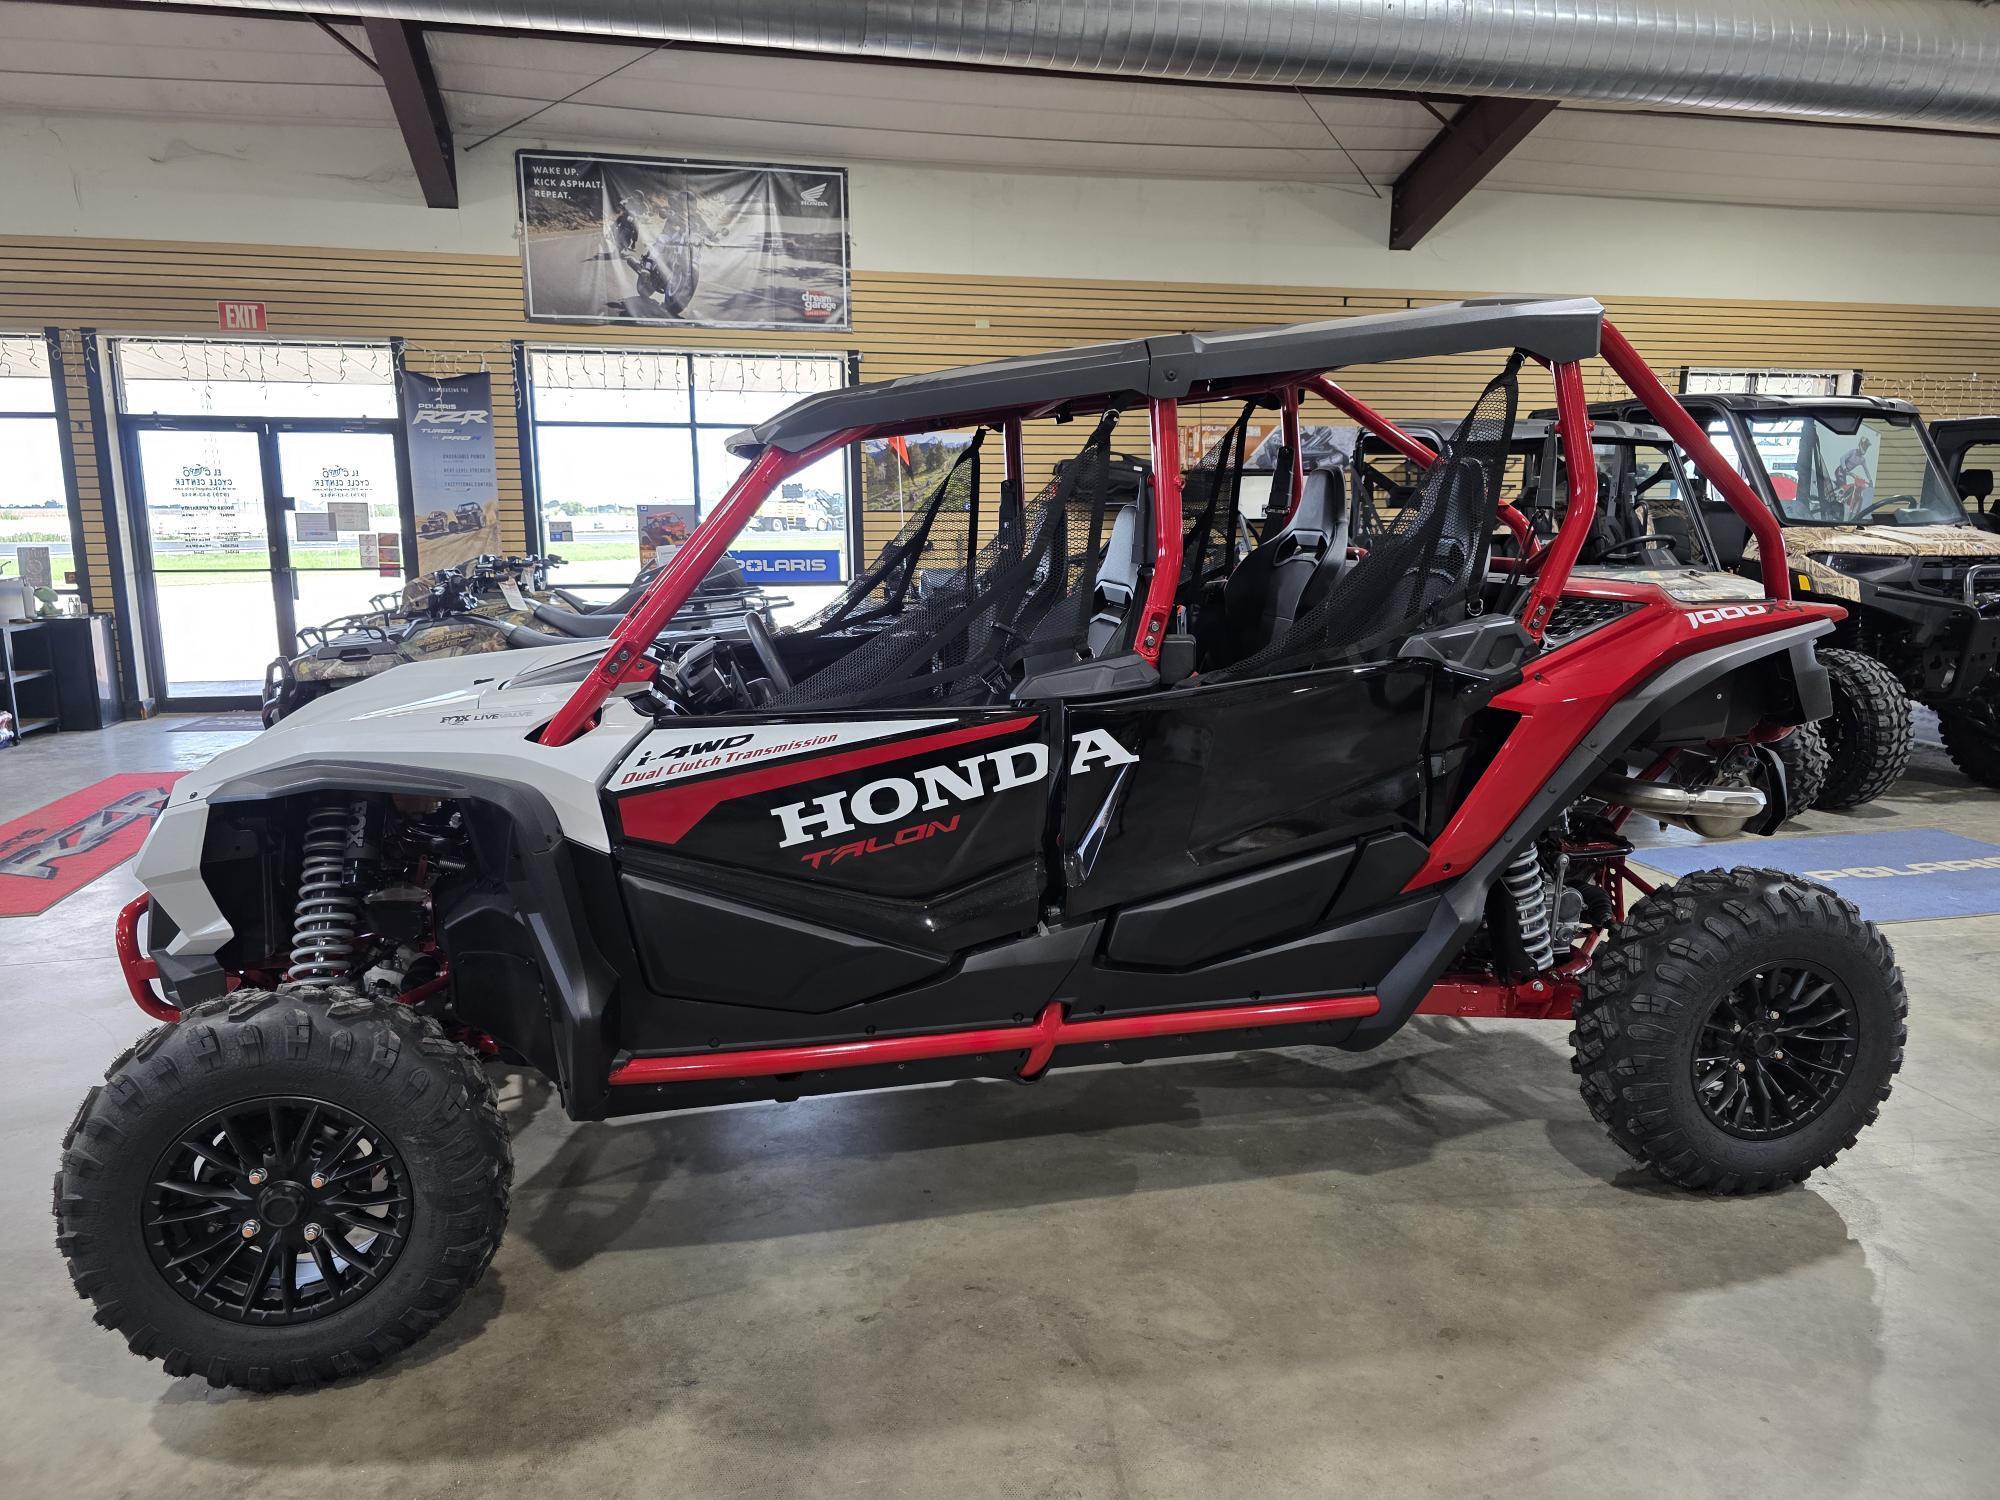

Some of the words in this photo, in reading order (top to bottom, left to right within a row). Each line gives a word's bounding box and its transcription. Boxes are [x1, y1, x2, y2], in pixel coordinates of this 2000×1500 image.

[533, 166, 560, 174] WAKE
[564, 168, 579, 176] UP.
[560, 181, 604, 189] ASPHALT.
[535, 190, 571, 200] REPEAT.
[802, 291, 832, 304] dream
[804, 301, 836, 313] garage
[225, 304, 258, 329] EXIT
[412, 410, 489, 425] RZR
[440, 714, 472, 725] FOX
[635, 733, 755, 768] i-4WD
[620, 766, 663, 785] Dual
[666, 752, 721, 776] Clutch
[722, 733, 839, 764] Transmission
[770, 728, 1140, 849] HONDA
[800, 814, 961, 870] TALON
